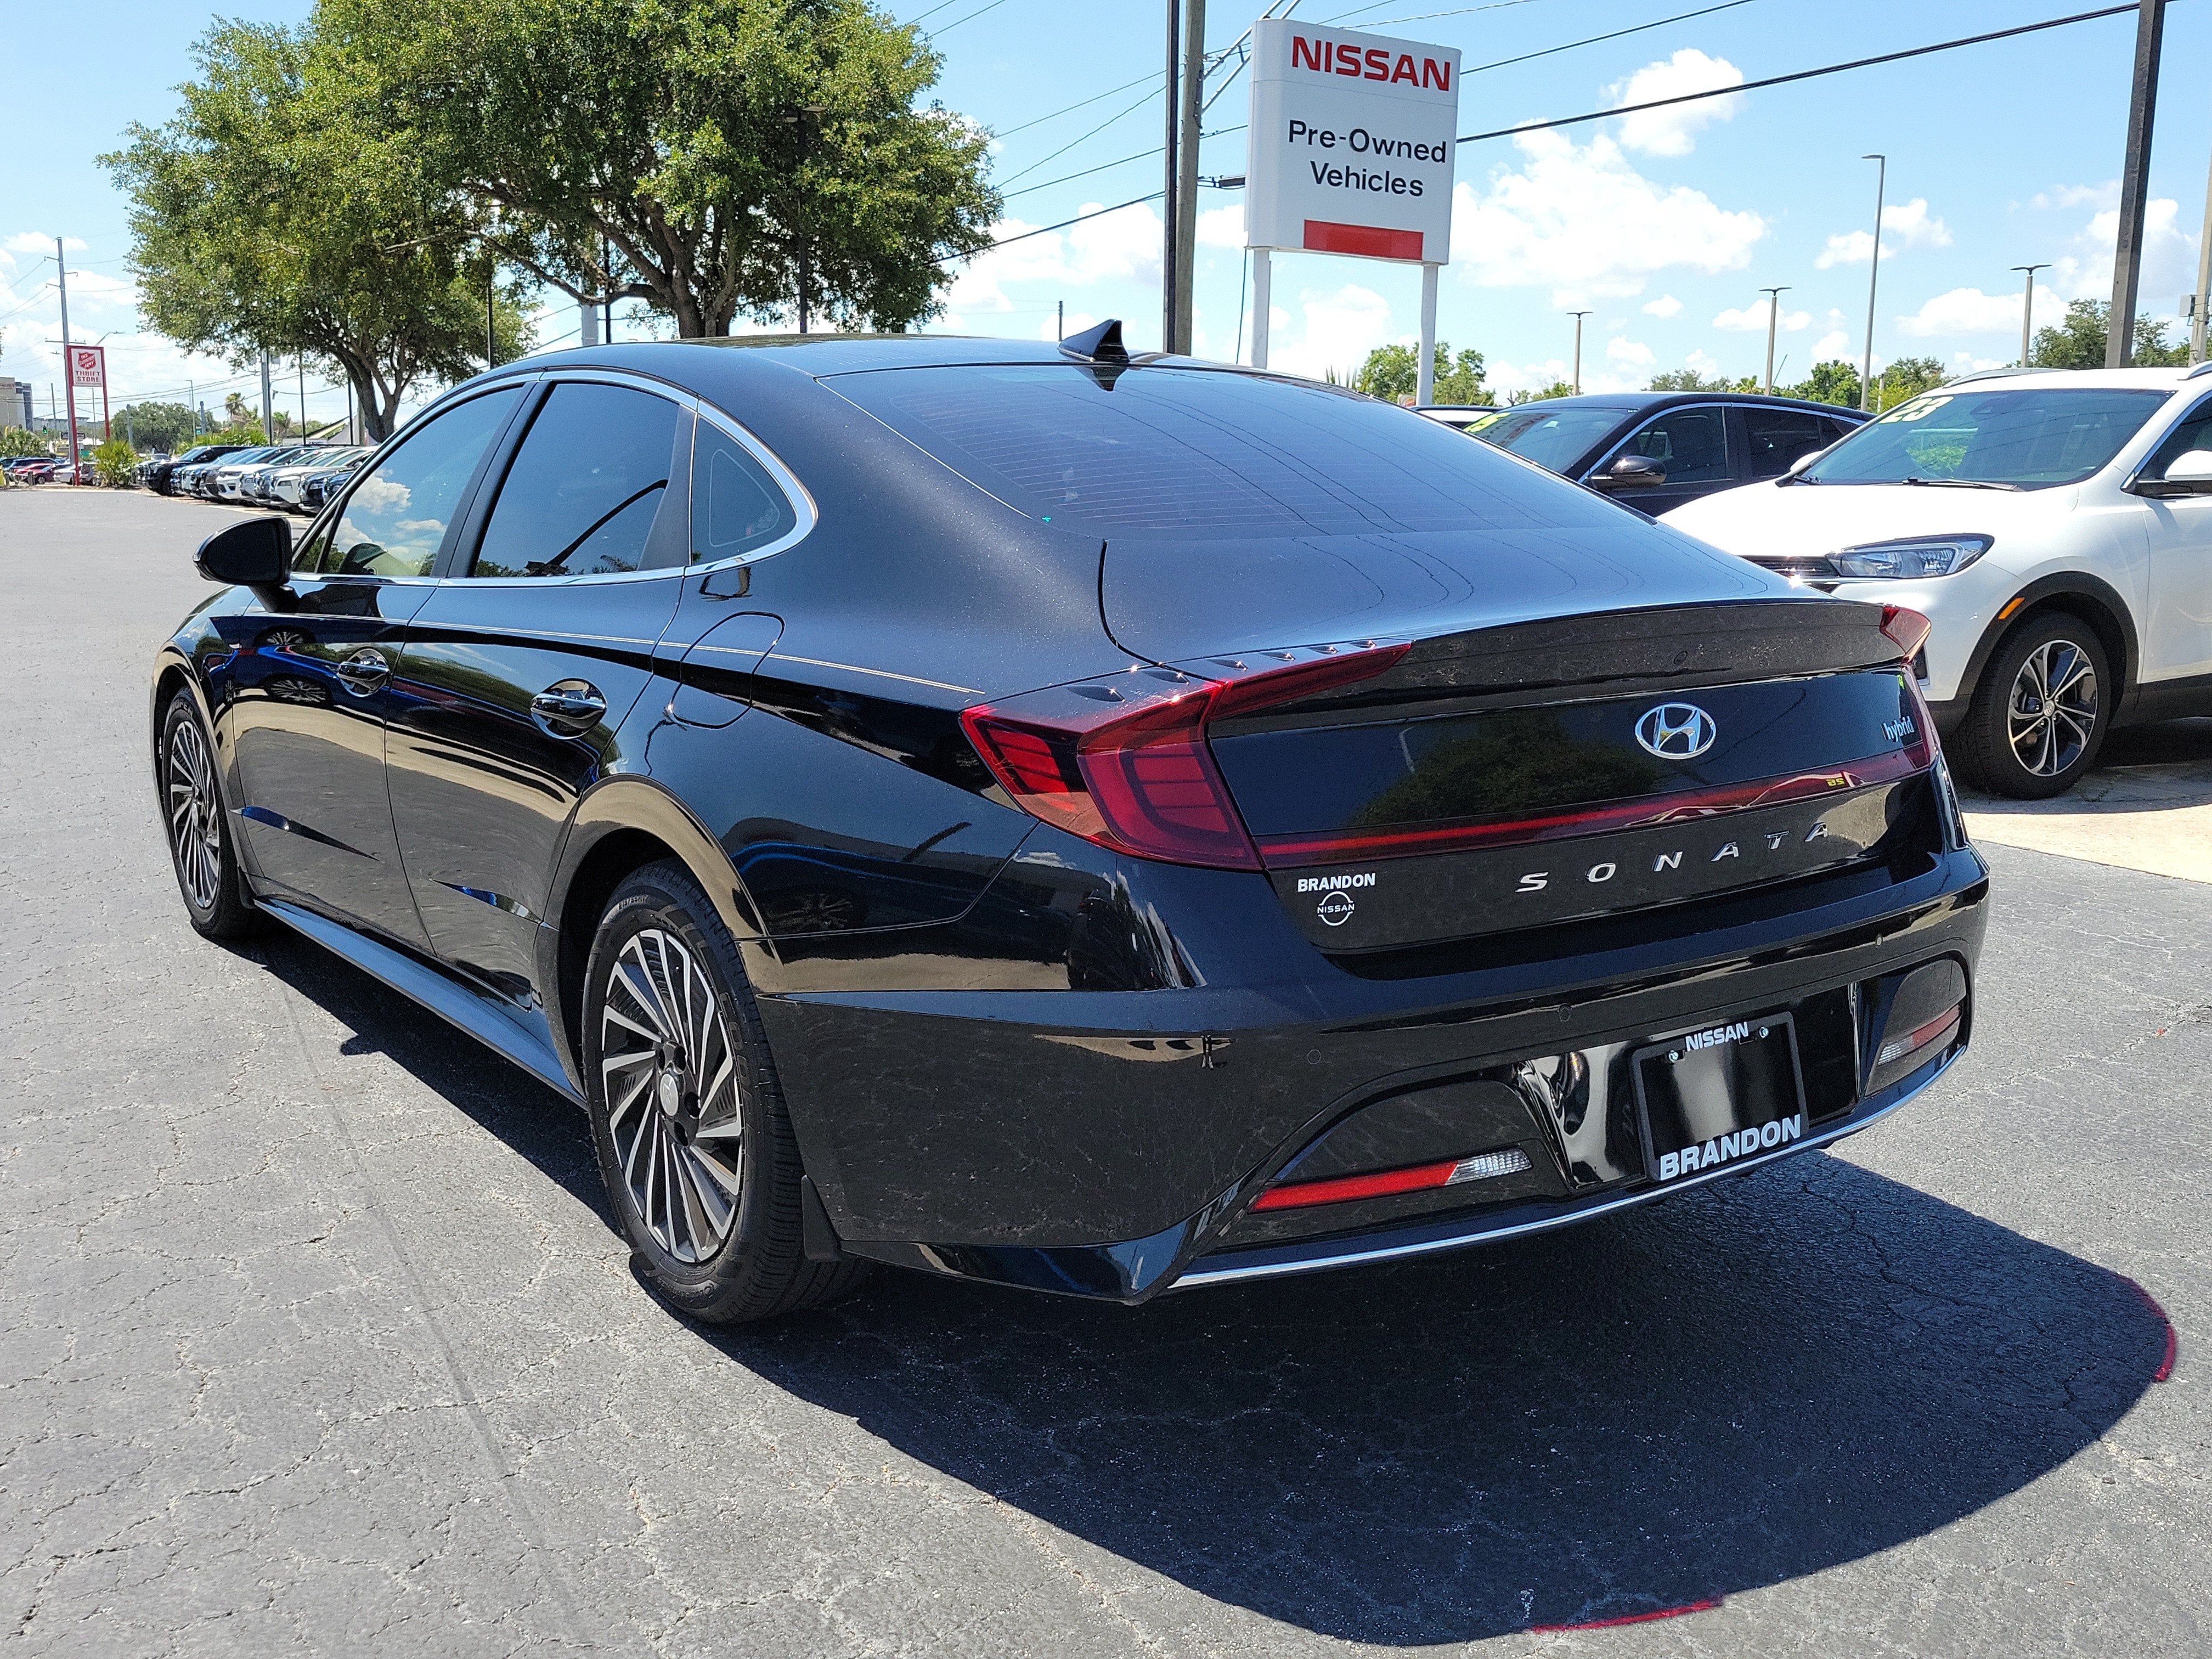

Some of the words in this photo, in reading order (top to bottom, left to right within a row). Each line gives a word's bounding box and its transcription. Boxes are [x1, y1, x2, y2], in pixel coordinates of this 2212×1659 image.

[1291, 36, 1451, 92] NISSAN
[1288, 119, 1447, 163] Pre-Owned
[1310, 161, 1424, 197] Vehicles
[1878, 396, 1954, 424] 23
[1882, 715, 1915, 742] hybrid
[1515, 822, 1829, 893] SONATA
[1297, 872, 1376, 892] BRANDON
[1317, 903, 1355, 914] NISSAN
[1685, 1022, 1749, 1052] NISSAN
[1660, 1114, 1801, 1181] BRANDON
